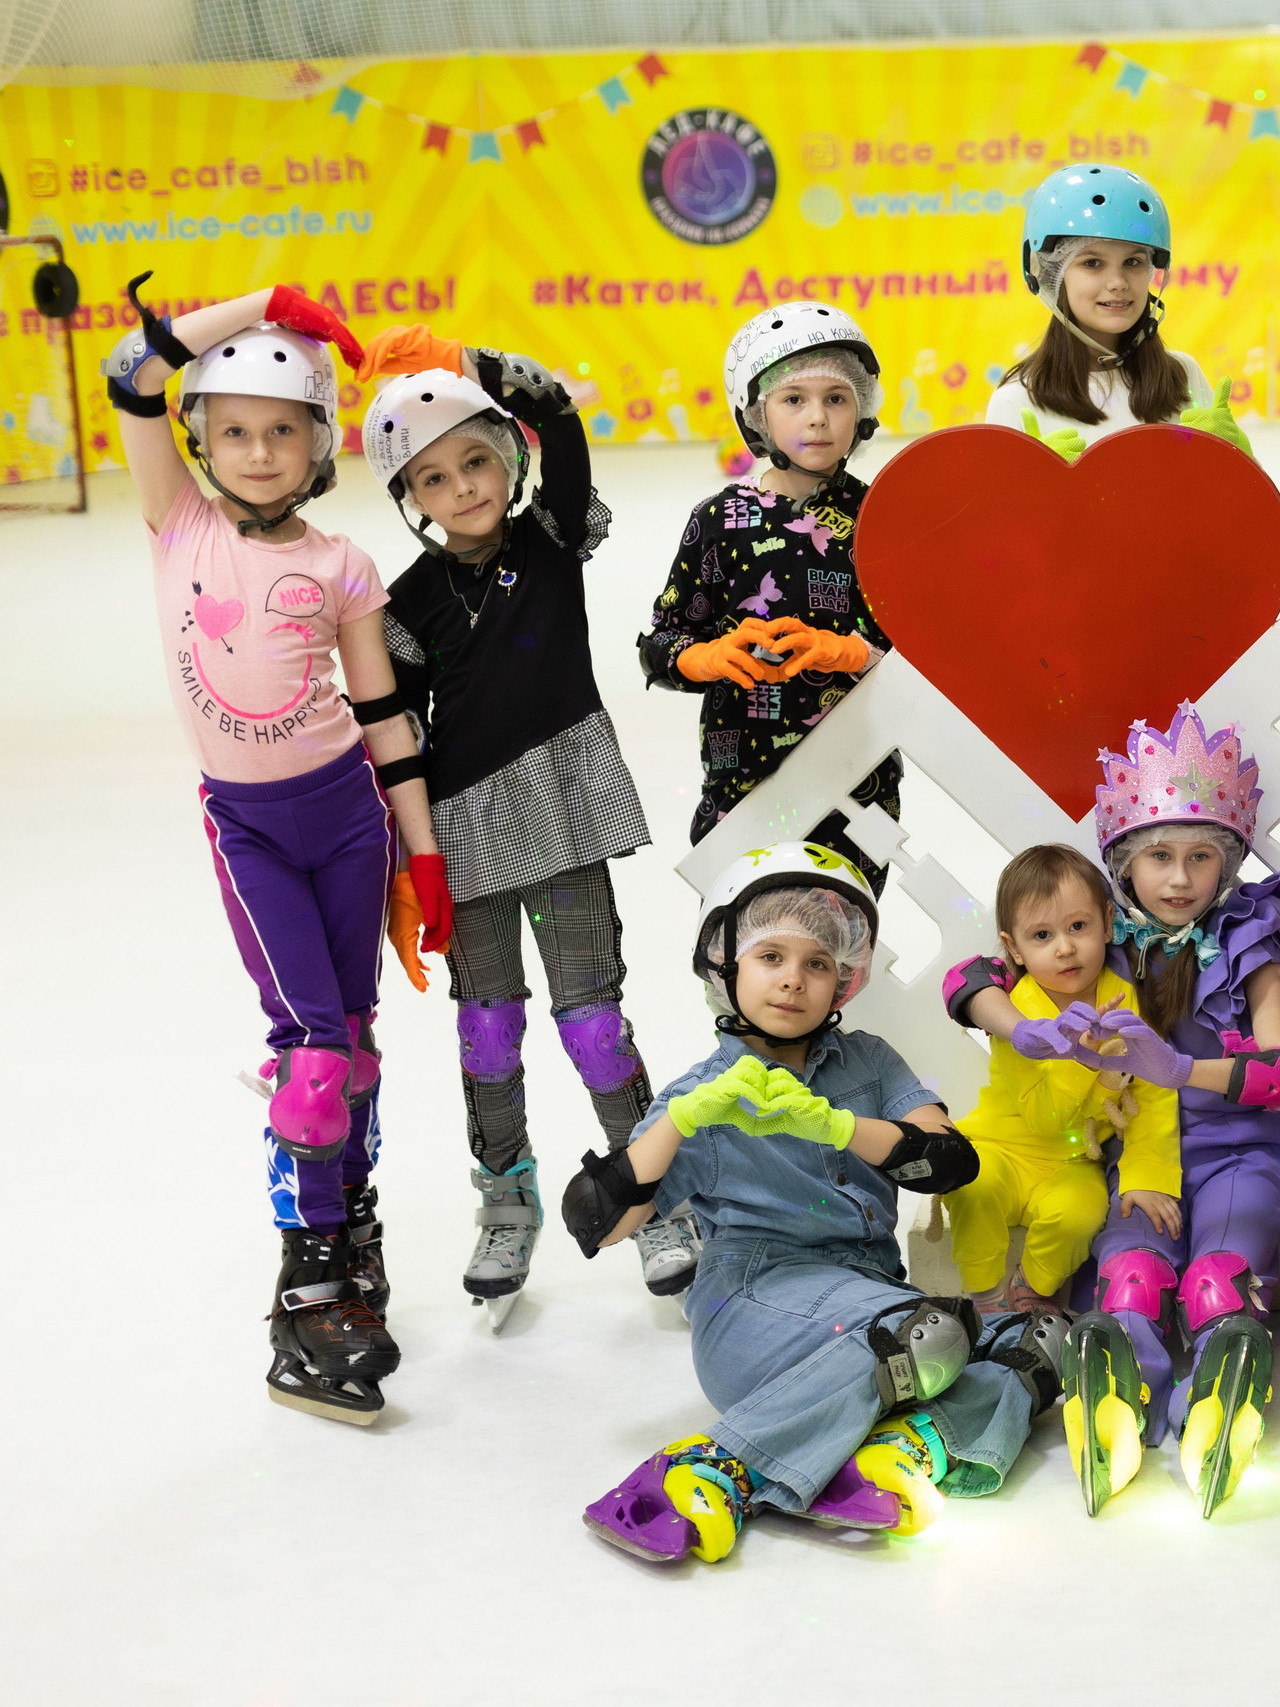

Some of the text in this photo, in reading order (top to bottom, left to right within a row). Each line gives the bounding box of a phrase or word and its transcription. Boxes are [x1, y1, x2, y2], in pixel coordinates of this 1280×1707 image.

[71, 205, 373, 246] www.ice-cafe.ru
[733, 259, 1009, 309] Доступный
[807, 330, 825, 344] НА
[724, 498, 736, 529] BLAH
[751, 536, 786, 557] hello
[807, 568, 851, 587] BLAH
[279, 585, 322, 609] NICE
[808, 582, 850, 600] BLAH
[808, 595, 850, 613] BLAH
[177, 650, 217, 720] SMILE
[218, 712, 247, 742] BE
[758, 685, 769, 719] BLAH
[769, 685, 781, 720] BLAH
[707, 729, 741, 745] BLAH
[709, 742, 739, 757] BLAH
[711, 754, 739, 770] BLAH
